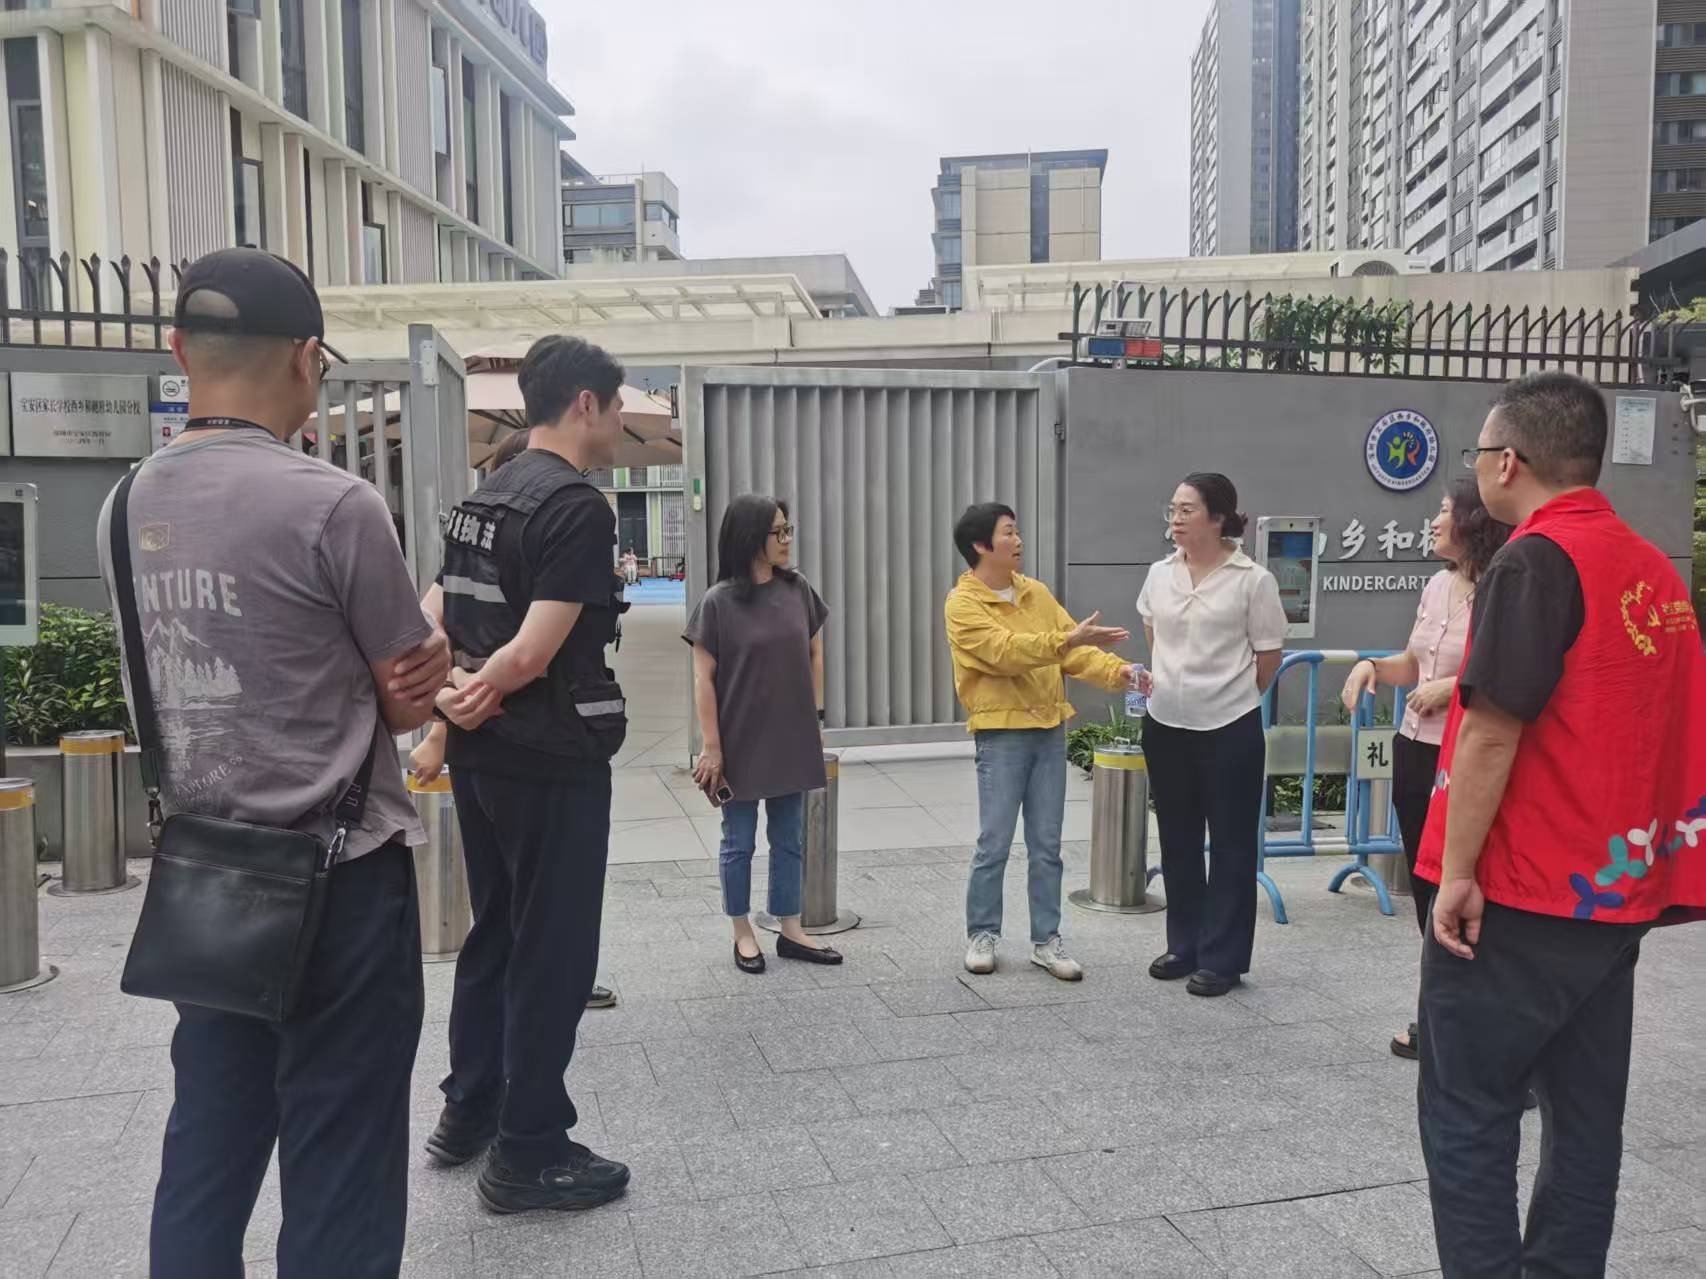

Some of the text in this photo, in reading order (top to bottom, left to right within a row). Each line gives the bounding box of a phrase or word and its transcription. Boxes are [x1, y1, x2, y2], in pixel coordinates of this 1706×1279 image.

[133, 568, 243, 617] NTURE
[1323, 574, 1433, 592] KINDERGART
[1367, 741, 1389, 768] 礼
